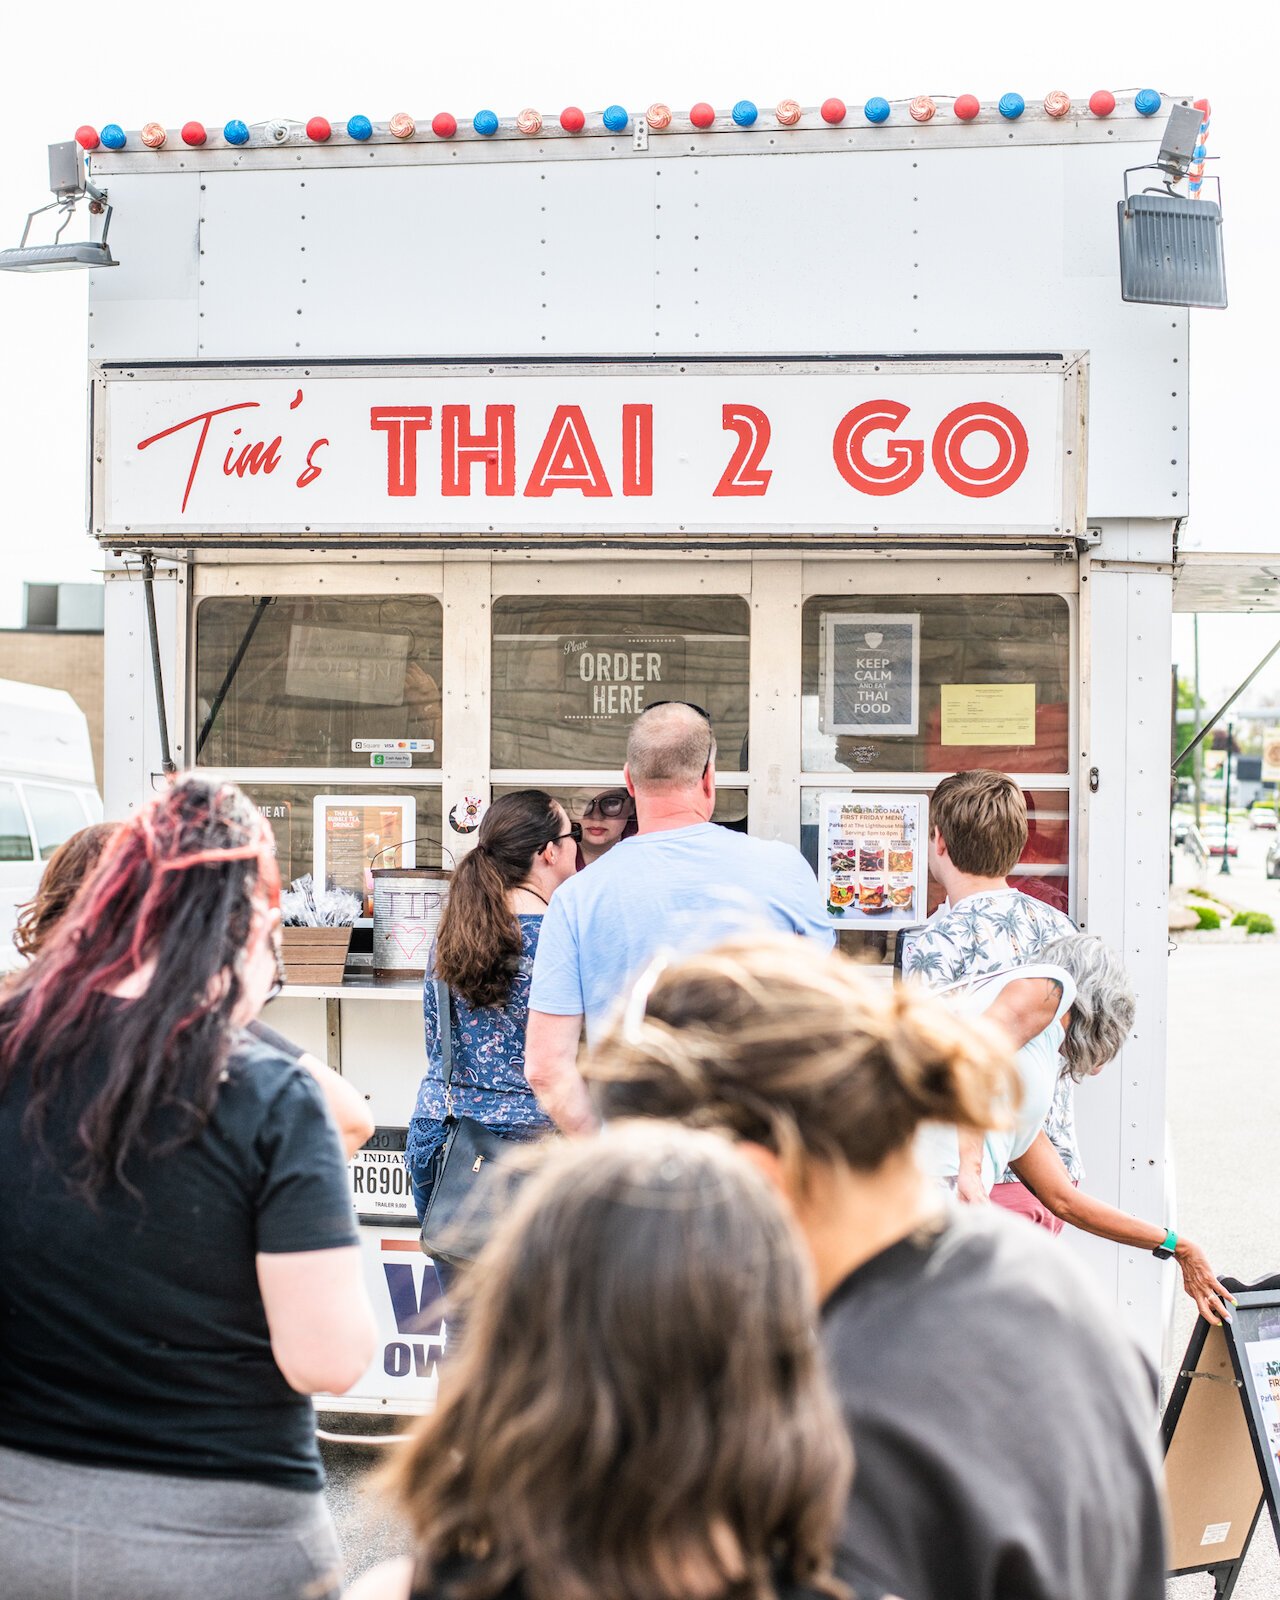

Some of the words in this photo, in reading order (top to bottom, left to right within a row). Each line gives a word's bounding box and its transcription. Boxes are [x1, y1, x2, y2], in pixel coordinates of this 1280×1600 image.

[137, 388, 329, 513] Tim's
[371, 403, 653, 497] THAI
[712, 403, 773, 497] 2
[833, 399, 1029, 498] GO
[563, 640, 589, 655] Please
[580, 652, 662, 681] ORDER
[856, 658, 890, 669] KEEP
[854, 670, 892, 681] CALM
[593, 685, 645, 714] HERE
[857, 691, 888, 701] THAI
[854, 703, 891, 714] FOOD
[273, 806, 286, 818] AT
